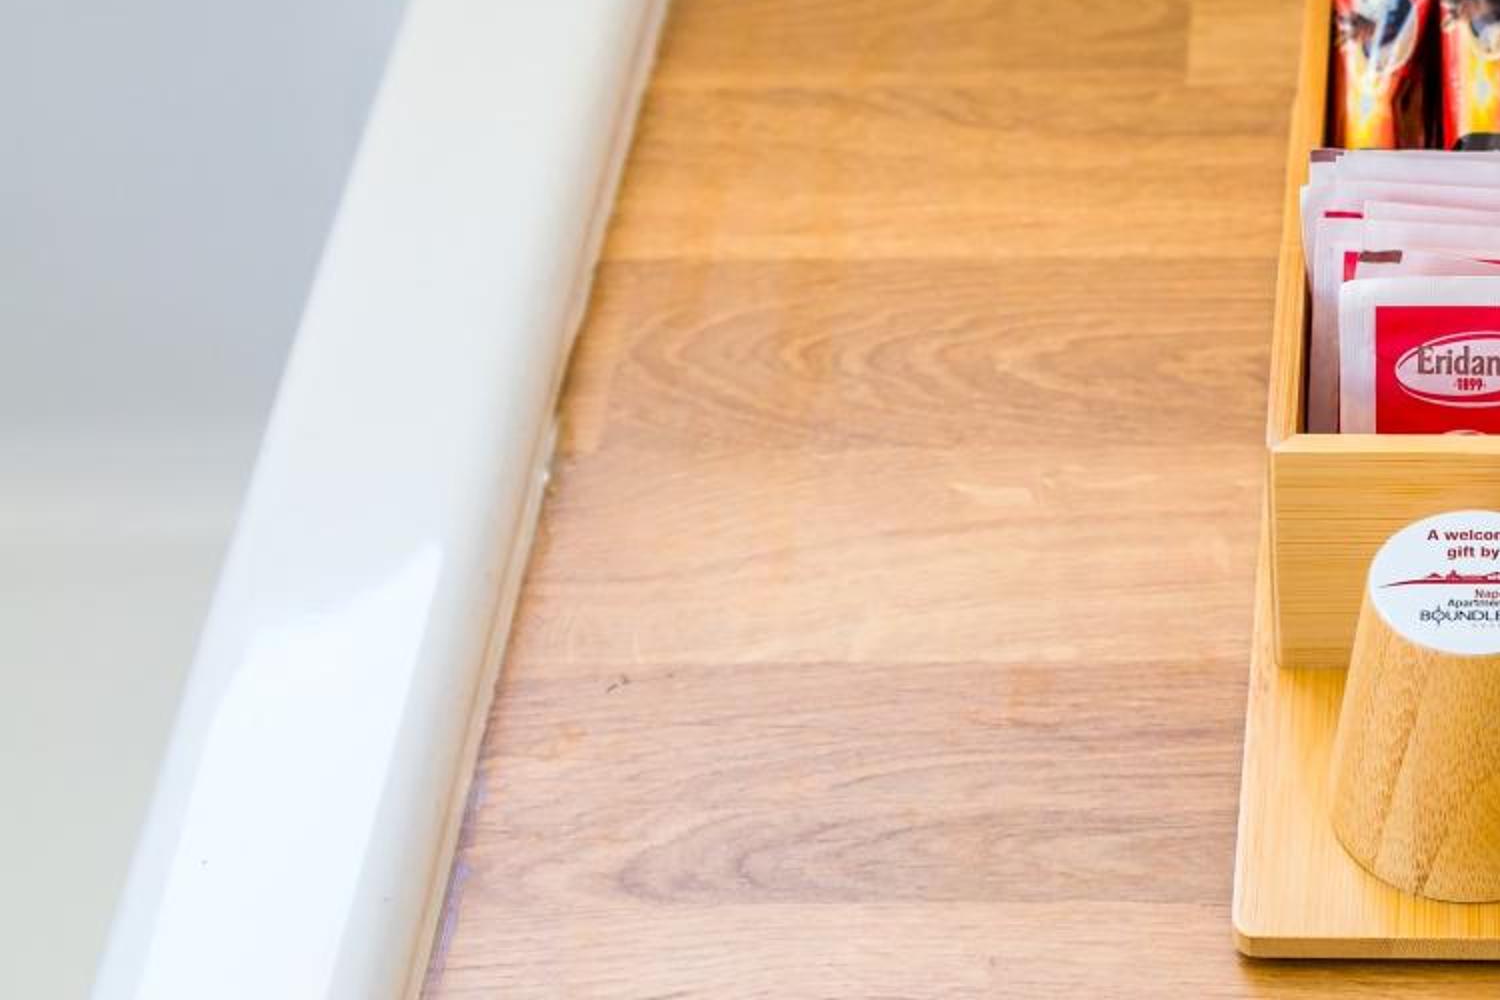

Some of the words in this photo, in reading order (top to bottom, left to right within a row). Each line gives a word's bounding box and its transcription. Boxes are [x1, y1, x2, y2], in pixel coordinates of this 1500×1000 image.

[1427, 529, 1439, 541] A
[1447, 545, 1475, 560] gift
[1481, 546, 1500, 560] by
